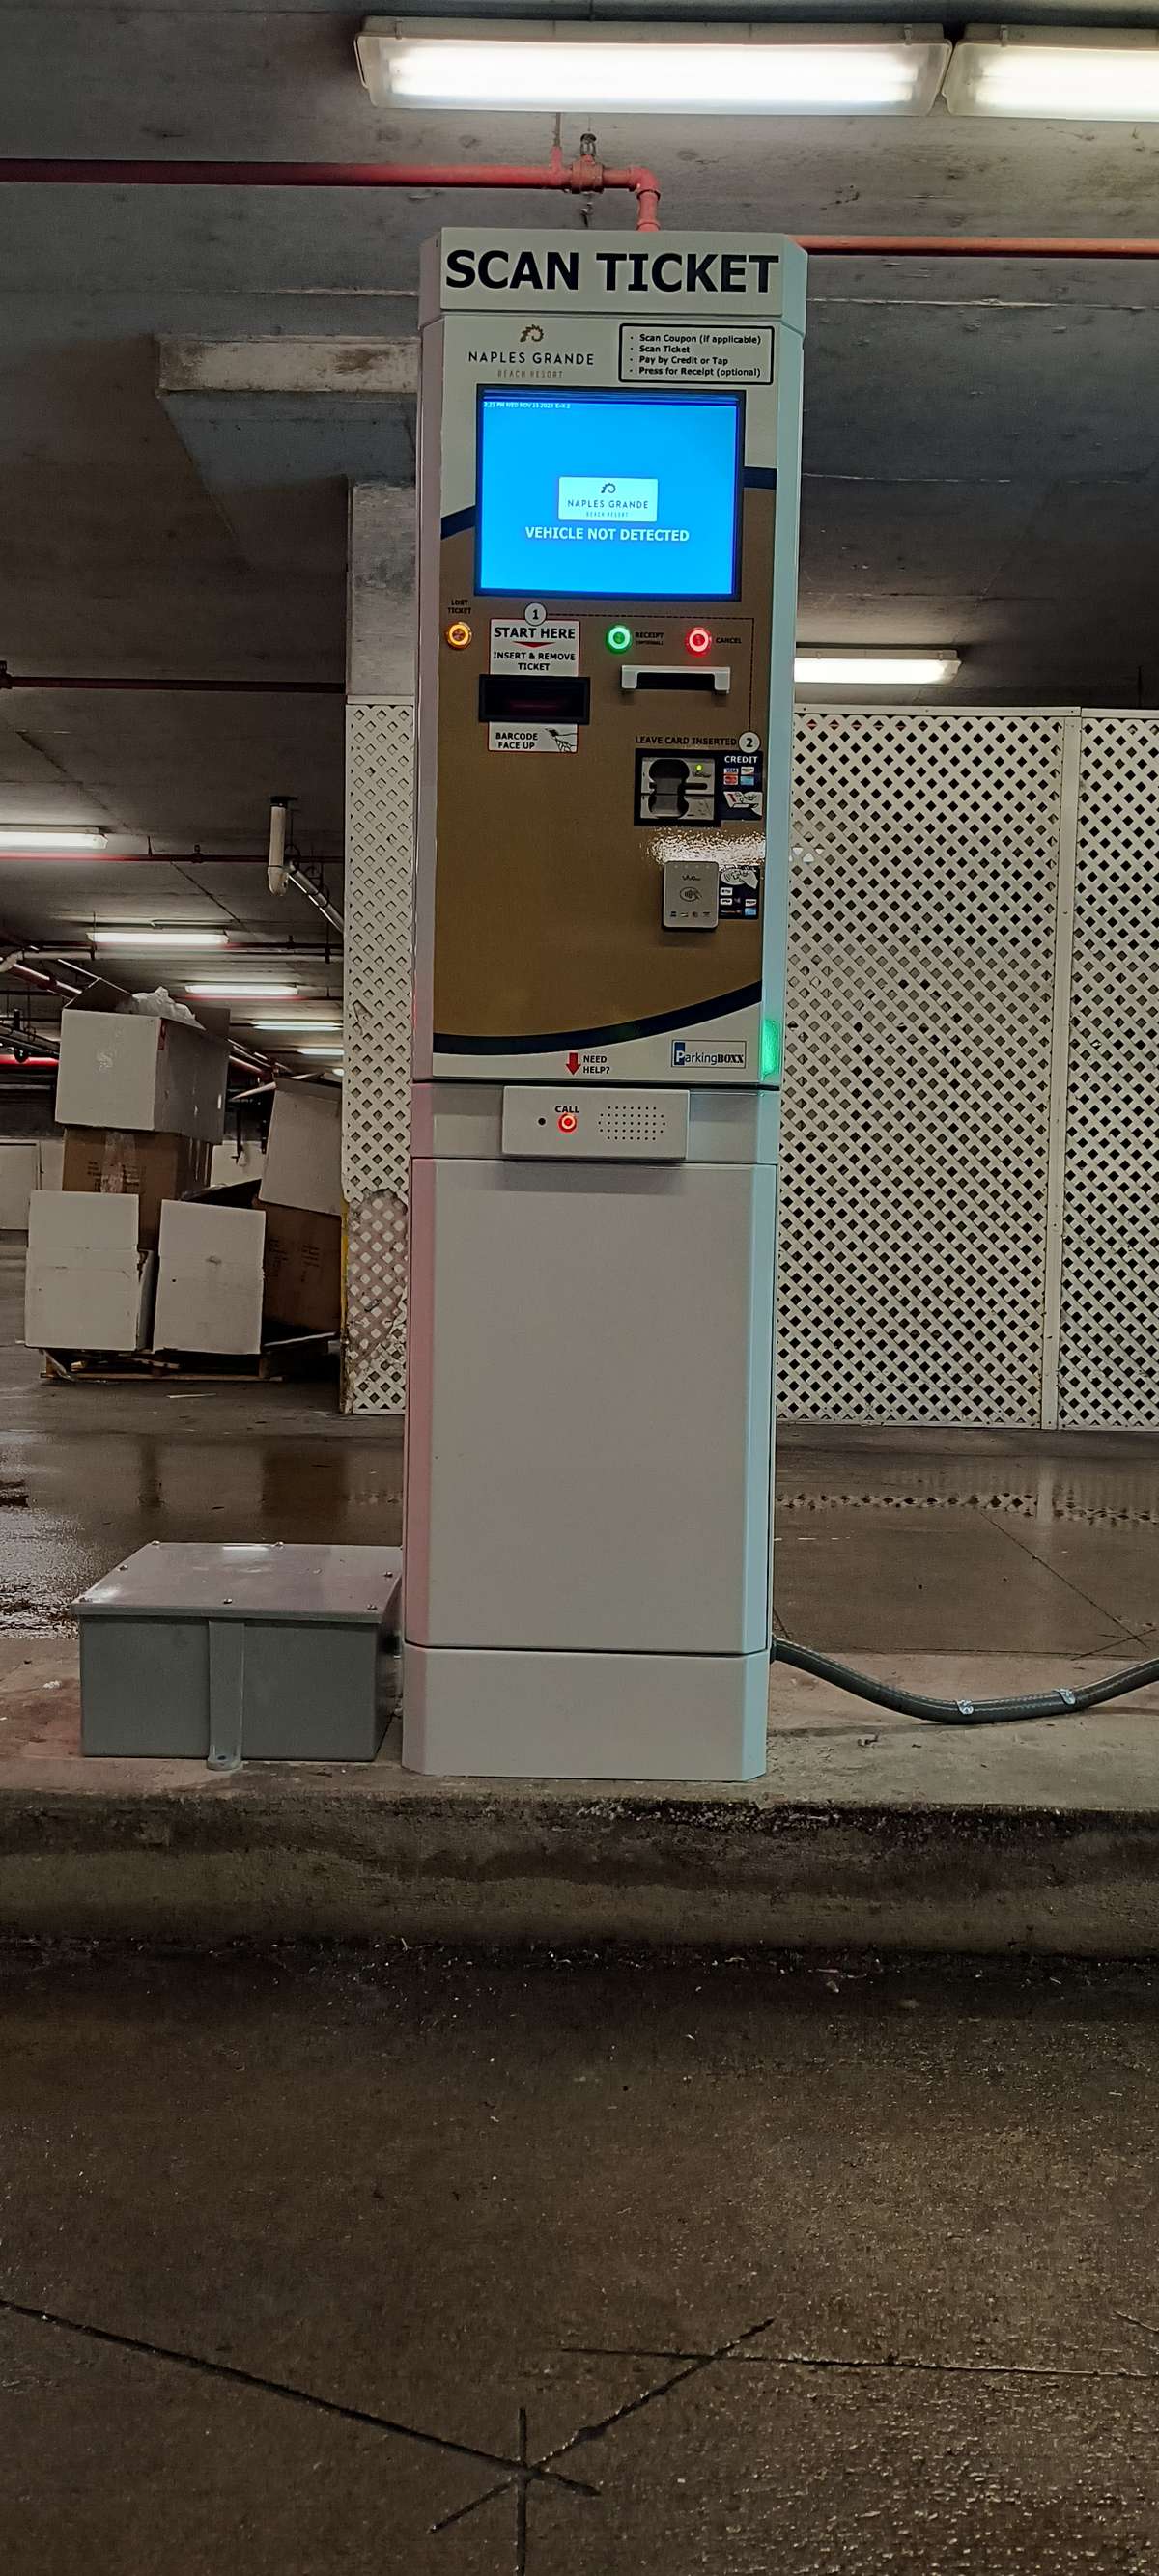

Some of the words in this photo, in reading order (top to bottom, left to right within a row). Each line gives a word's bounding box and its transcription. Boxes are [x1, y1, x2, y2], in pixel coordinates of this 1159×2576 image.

[445, 249, 579, 290] SCAN
[595, 252, 779, 293] TICKET
[639, 333, 661, 342] Scan
[663, 334, 696, 345] Coupon
[699, 334, 710, 345] (if
[712, 335, 761, 345] applicable)
[664, 345, 690, 353] Ticket
[468, 350, 526, 364] NAPLES
[532, 352, 594, 365] GRANDE
[639, 355, 656, 365] Pay
[658, 355, 668, 365] by
[671, 355, 697, 364] Credit
[712, 356, 728, 366] Tap
[497, 370, 526, 378] BEACH
[530, 370, 563, 378] RESORT
[681, 367, 714, 377] Receipt
[717, 367, 761, 377] (optional)
[567, 499, 605, 508] NAPLES
[608, 500, 649, 509] GRANDE
[524, 526, 583, 540] VEHICLE
[587, 527, 617, 541] NOT
[620, 528, 690, 542] DETECTED
[532, 610, 539, 620] 1
[494, 627, 536, 638] START
[541, 628, 576, 639] HERE
[494, 651, 526, 659] INSERT
[538, 652, 576, 660] REMOVE
[518, 662, 551, 671] TICKET
[495, 732, 538, 741] BARCODE
[664, 736, 690, 744] CARD
[692, 737, 737, 745] INSERTED
[746, 737, 753, 748] 2
[724, 755, 758, 764] CREDIT
[582, 1055, 608, 1064] NEED
[582, 1066, 610, 1075] HELP?
